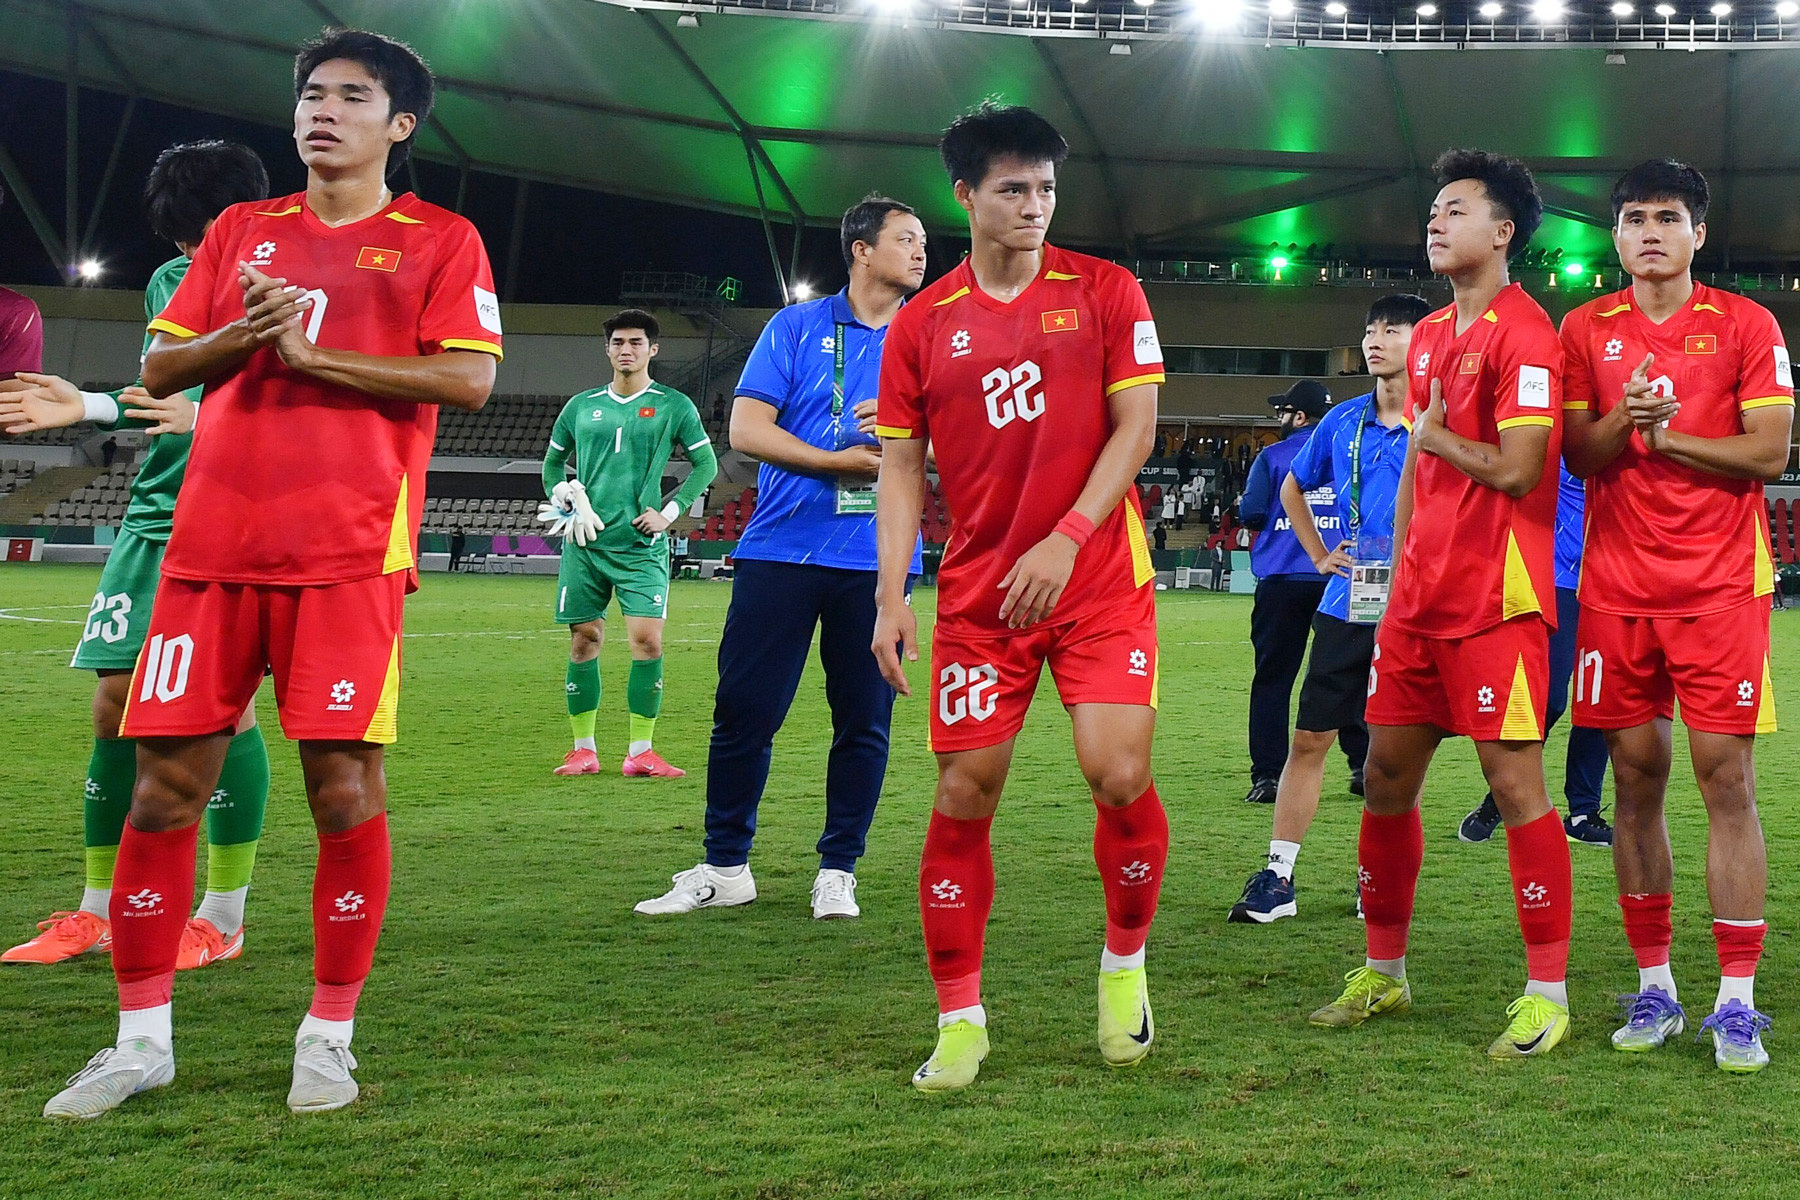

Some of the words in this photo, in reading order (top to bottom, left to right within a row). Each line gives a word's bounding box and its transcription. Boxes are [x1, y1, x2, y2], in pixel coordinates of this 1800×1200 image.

[479, 303, 496, 317] AFC
[1136, 336, 1155, 347] AFC
[981, 359, 1046, 430] 22
[1522, 381, 1545, 392] AFC
[614, 426, 623, 454] 1
[1140, 467, 1160, 475] CUP
[559, 585, 567, 613] 1
[82, 591, 133, 644] 23
[139, 632, 195, 704] 10
[1576, 646, 1604, 706] 17
[939, 661, 1000, 727] 22
